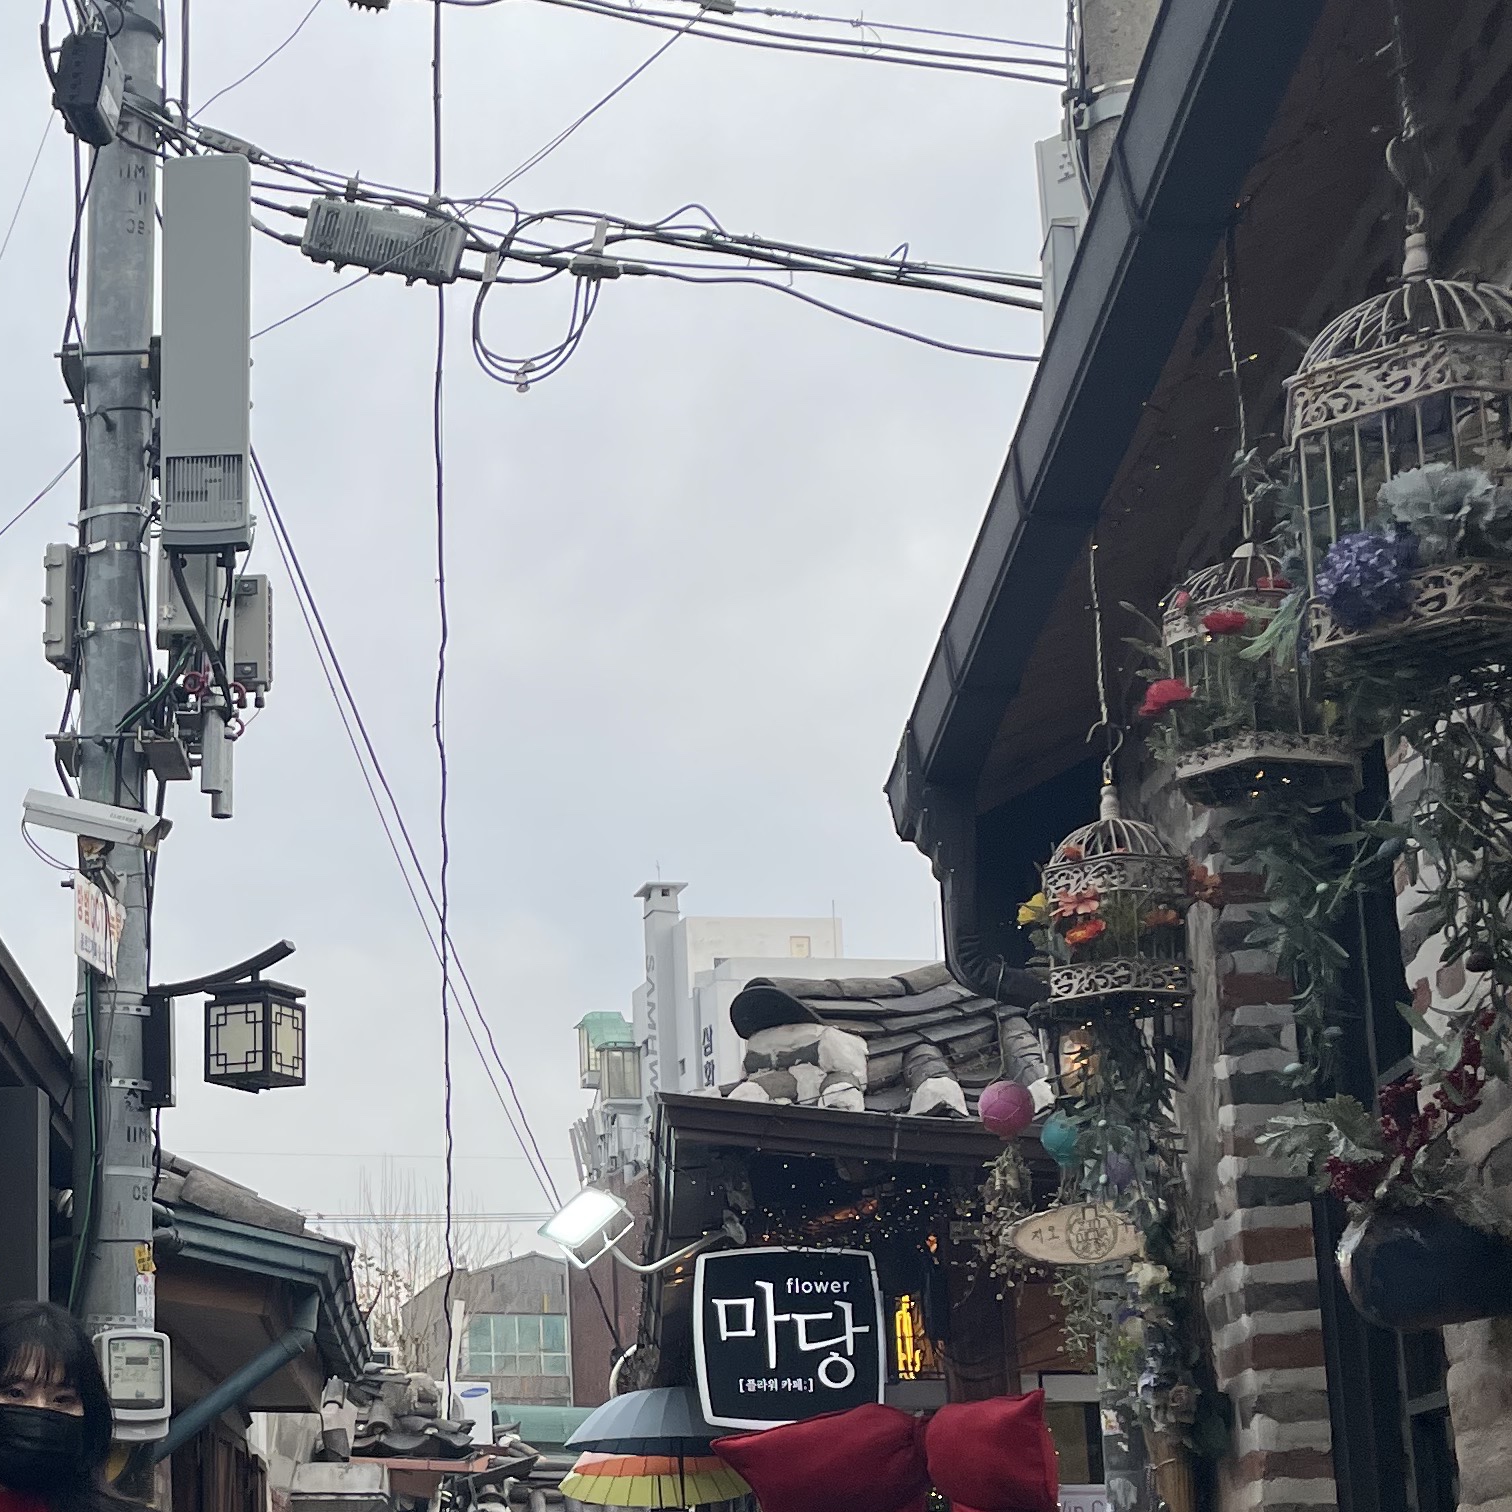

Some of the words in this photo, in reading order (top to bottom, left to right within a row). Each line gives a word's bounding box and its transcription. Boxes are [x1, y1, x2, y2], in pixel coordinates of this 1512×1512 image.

[645, 954, 660, 1092] SAMHW
[711, 1280, 870, 1389] 마당
[786, 1277, 850, 1294] flower
